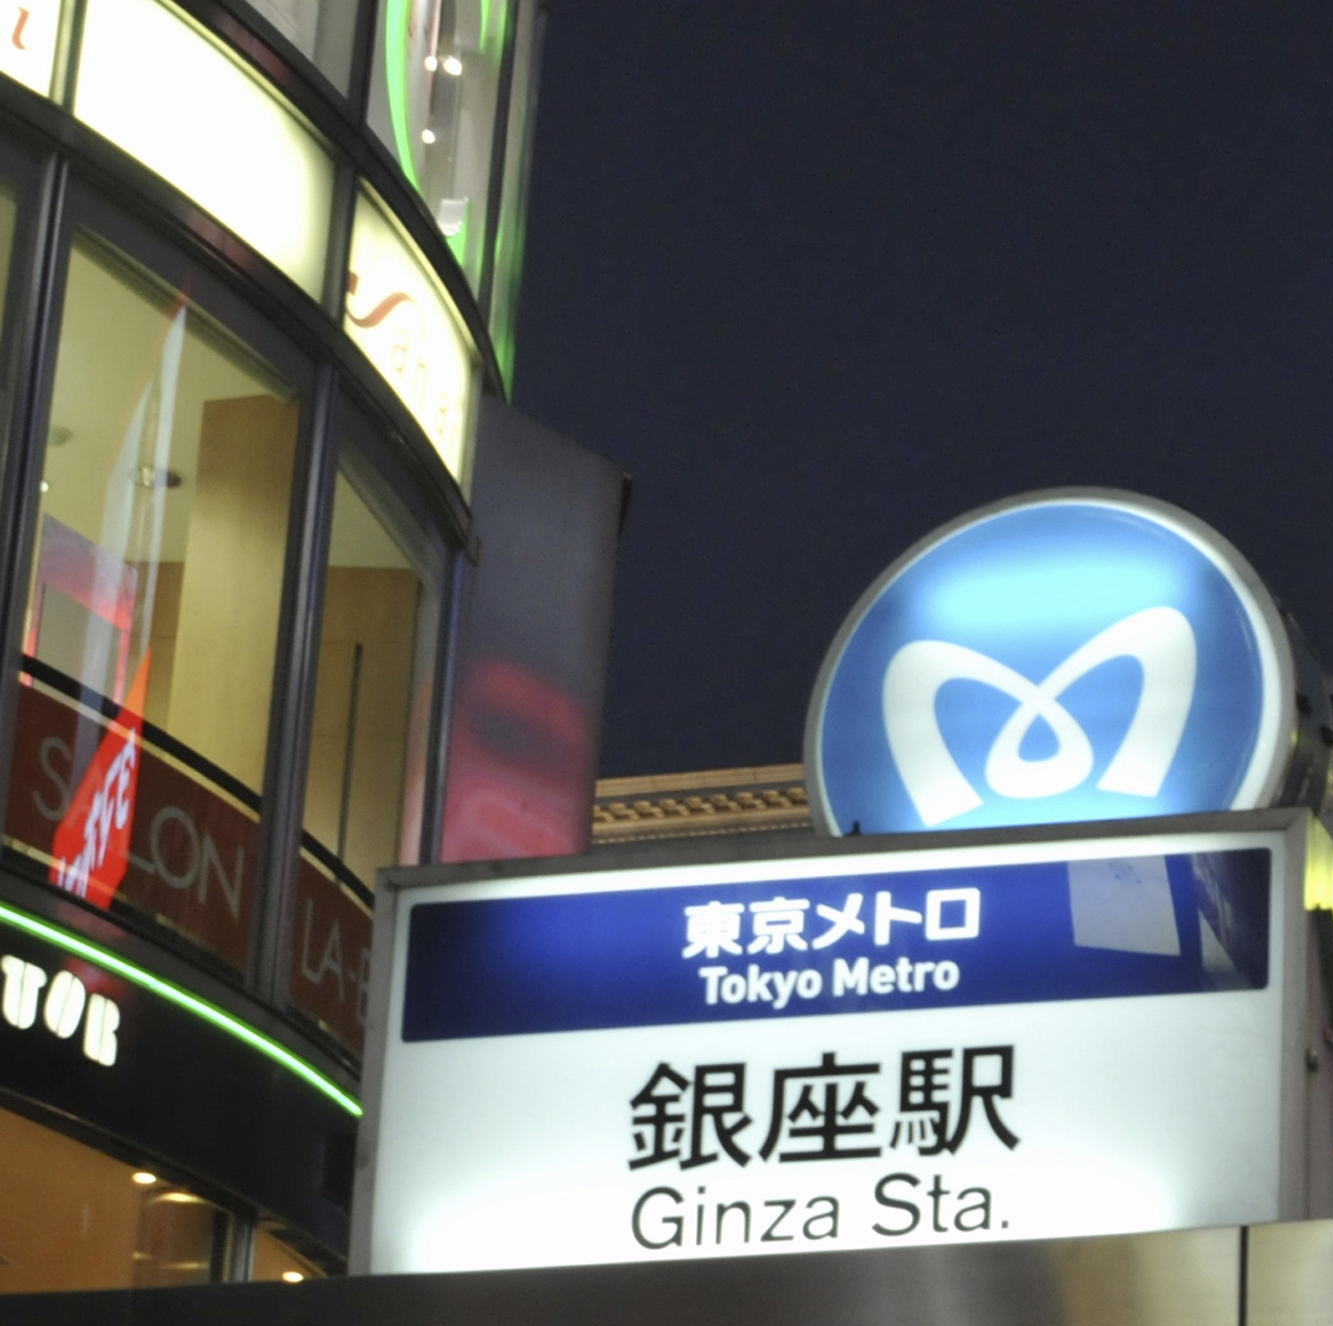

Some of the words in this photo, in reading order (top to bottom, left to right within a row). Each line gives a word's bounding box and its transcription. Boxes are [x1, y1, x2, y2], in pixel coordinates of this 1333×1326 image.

[682, 887, 980, 959] 東京メトロ
[699, 963, 821, 1010] Tokyo
[832, 955, 961, 997] Metro
[628, 1043, 1021, 1170] 銀座駅
[631, 1183, 842, 1252] Ginza
[872, 1171, 1011, 1239] Sta.
